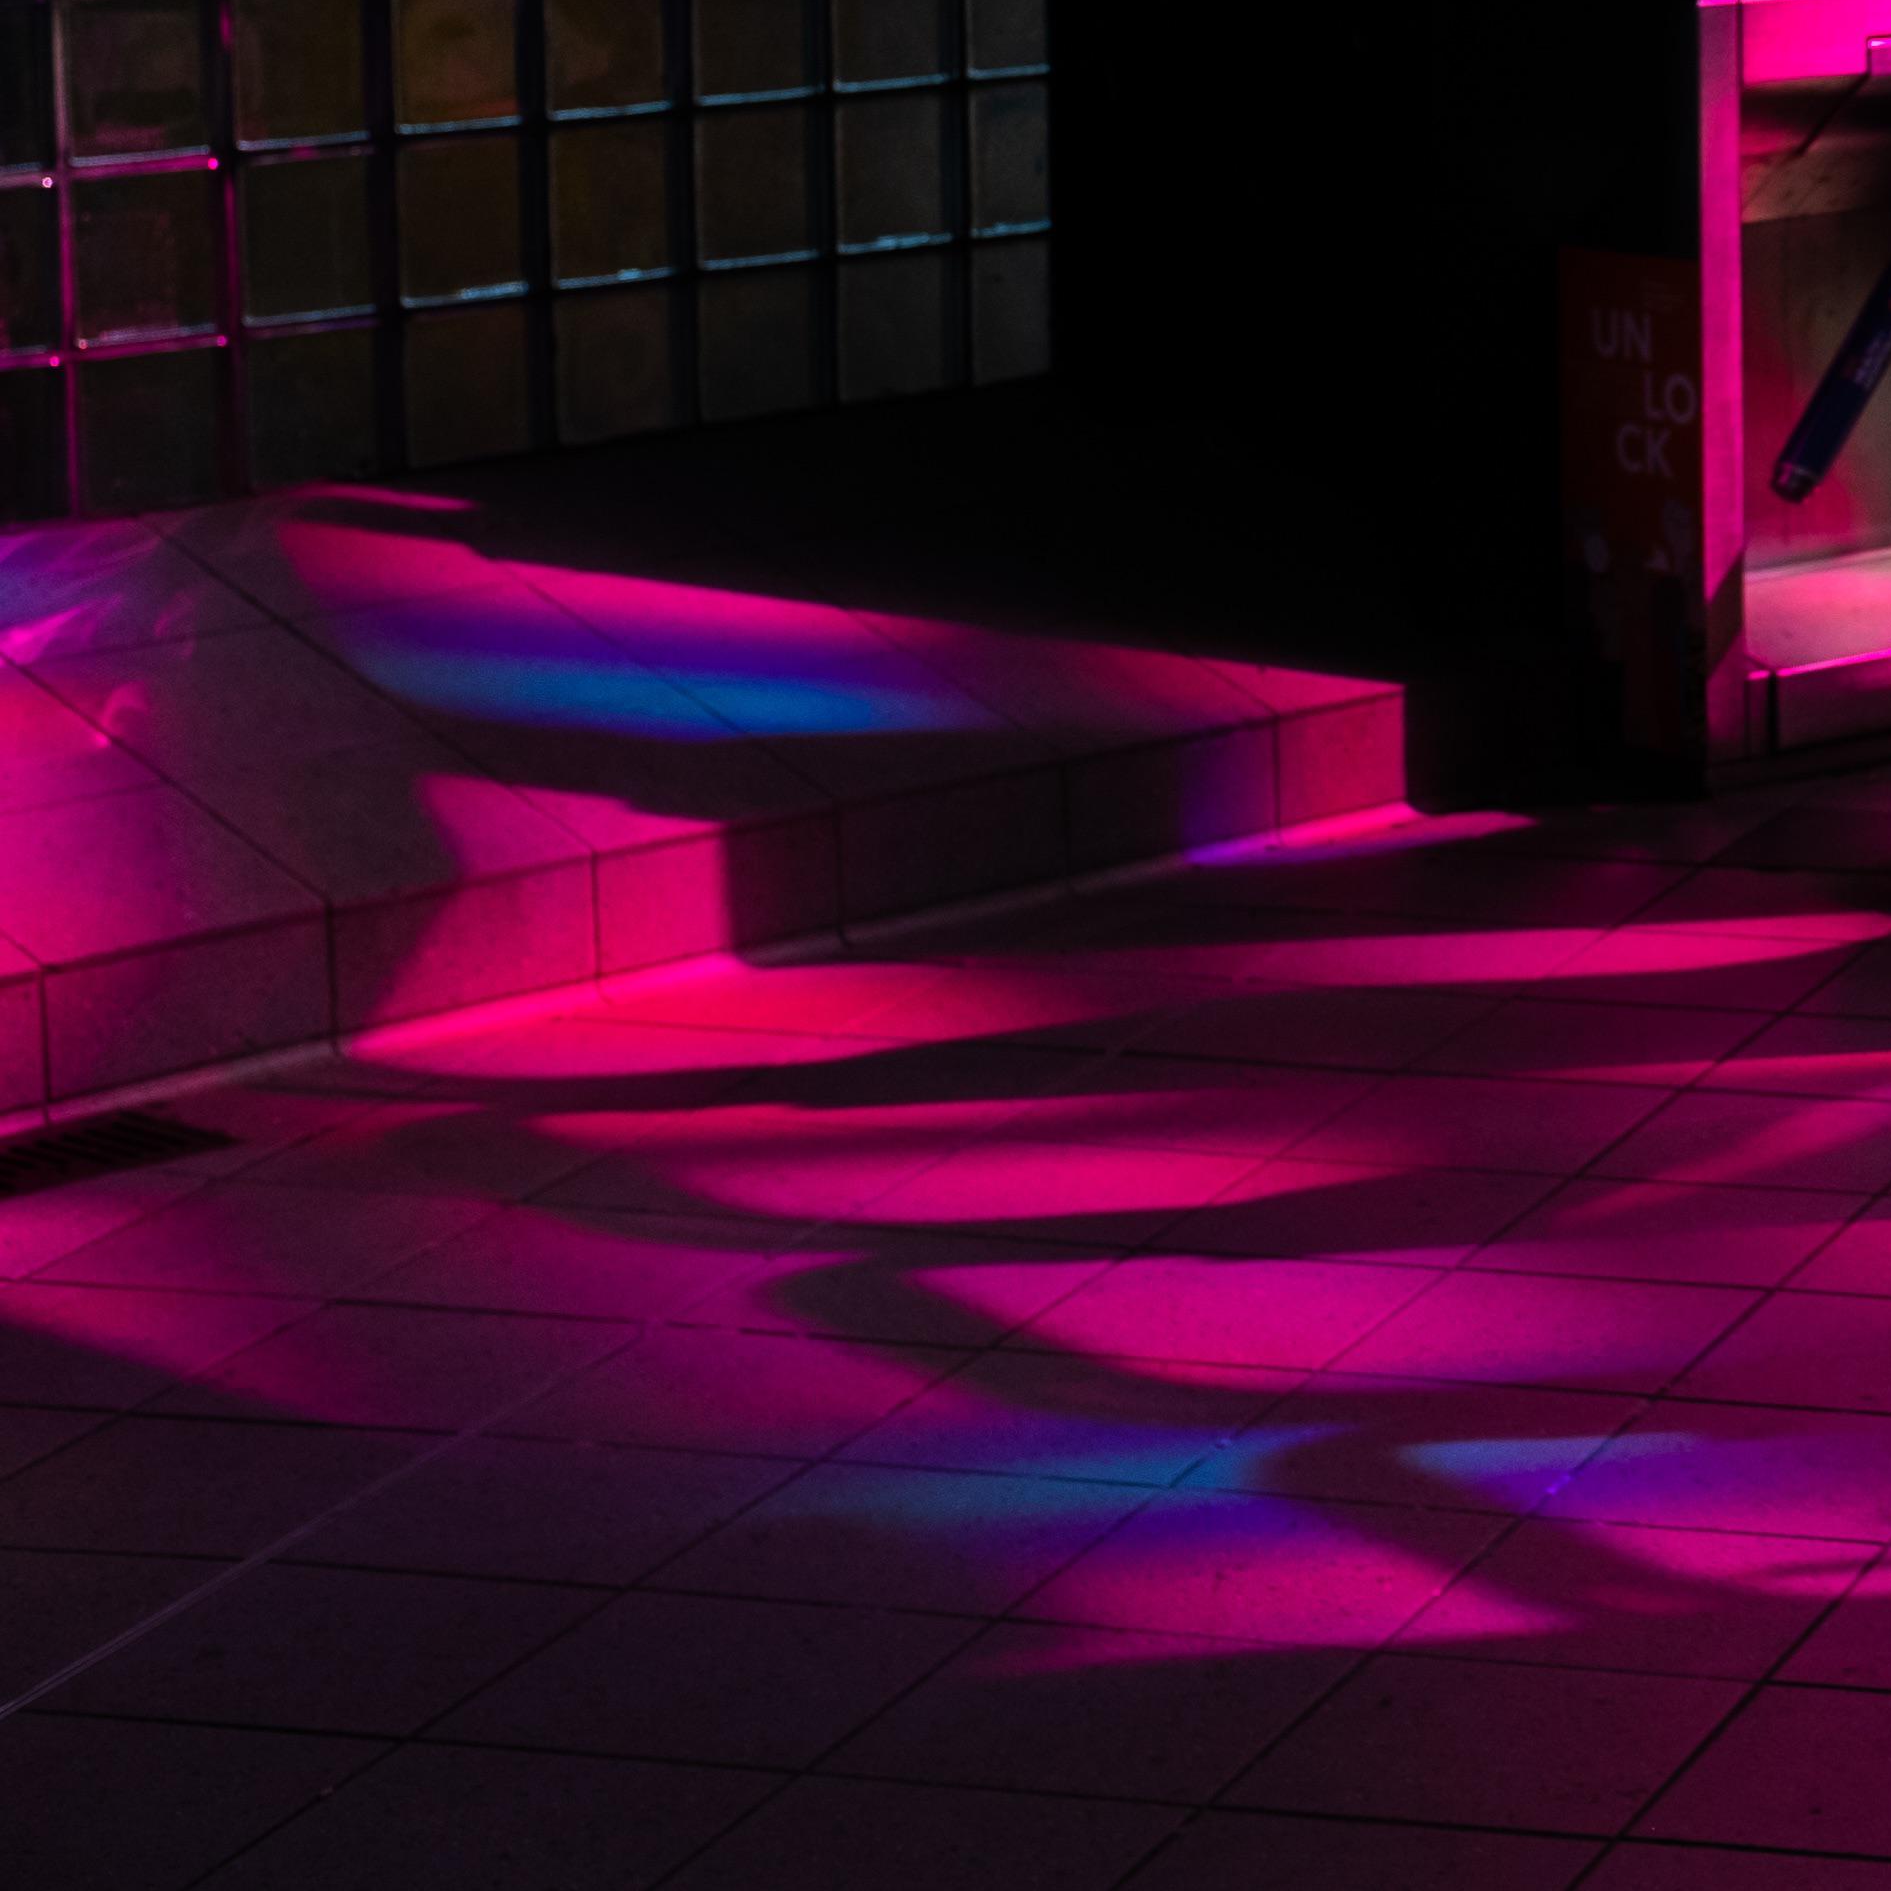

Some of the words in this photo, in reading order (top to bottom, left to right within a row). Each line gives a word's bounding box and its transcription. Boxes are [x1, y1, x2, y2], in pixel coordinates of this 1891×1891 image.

[1590, 307, 1652, 362] UN
[1643, 369, 1697, 426] LO
[1616, 423, 1676, 480] CK
